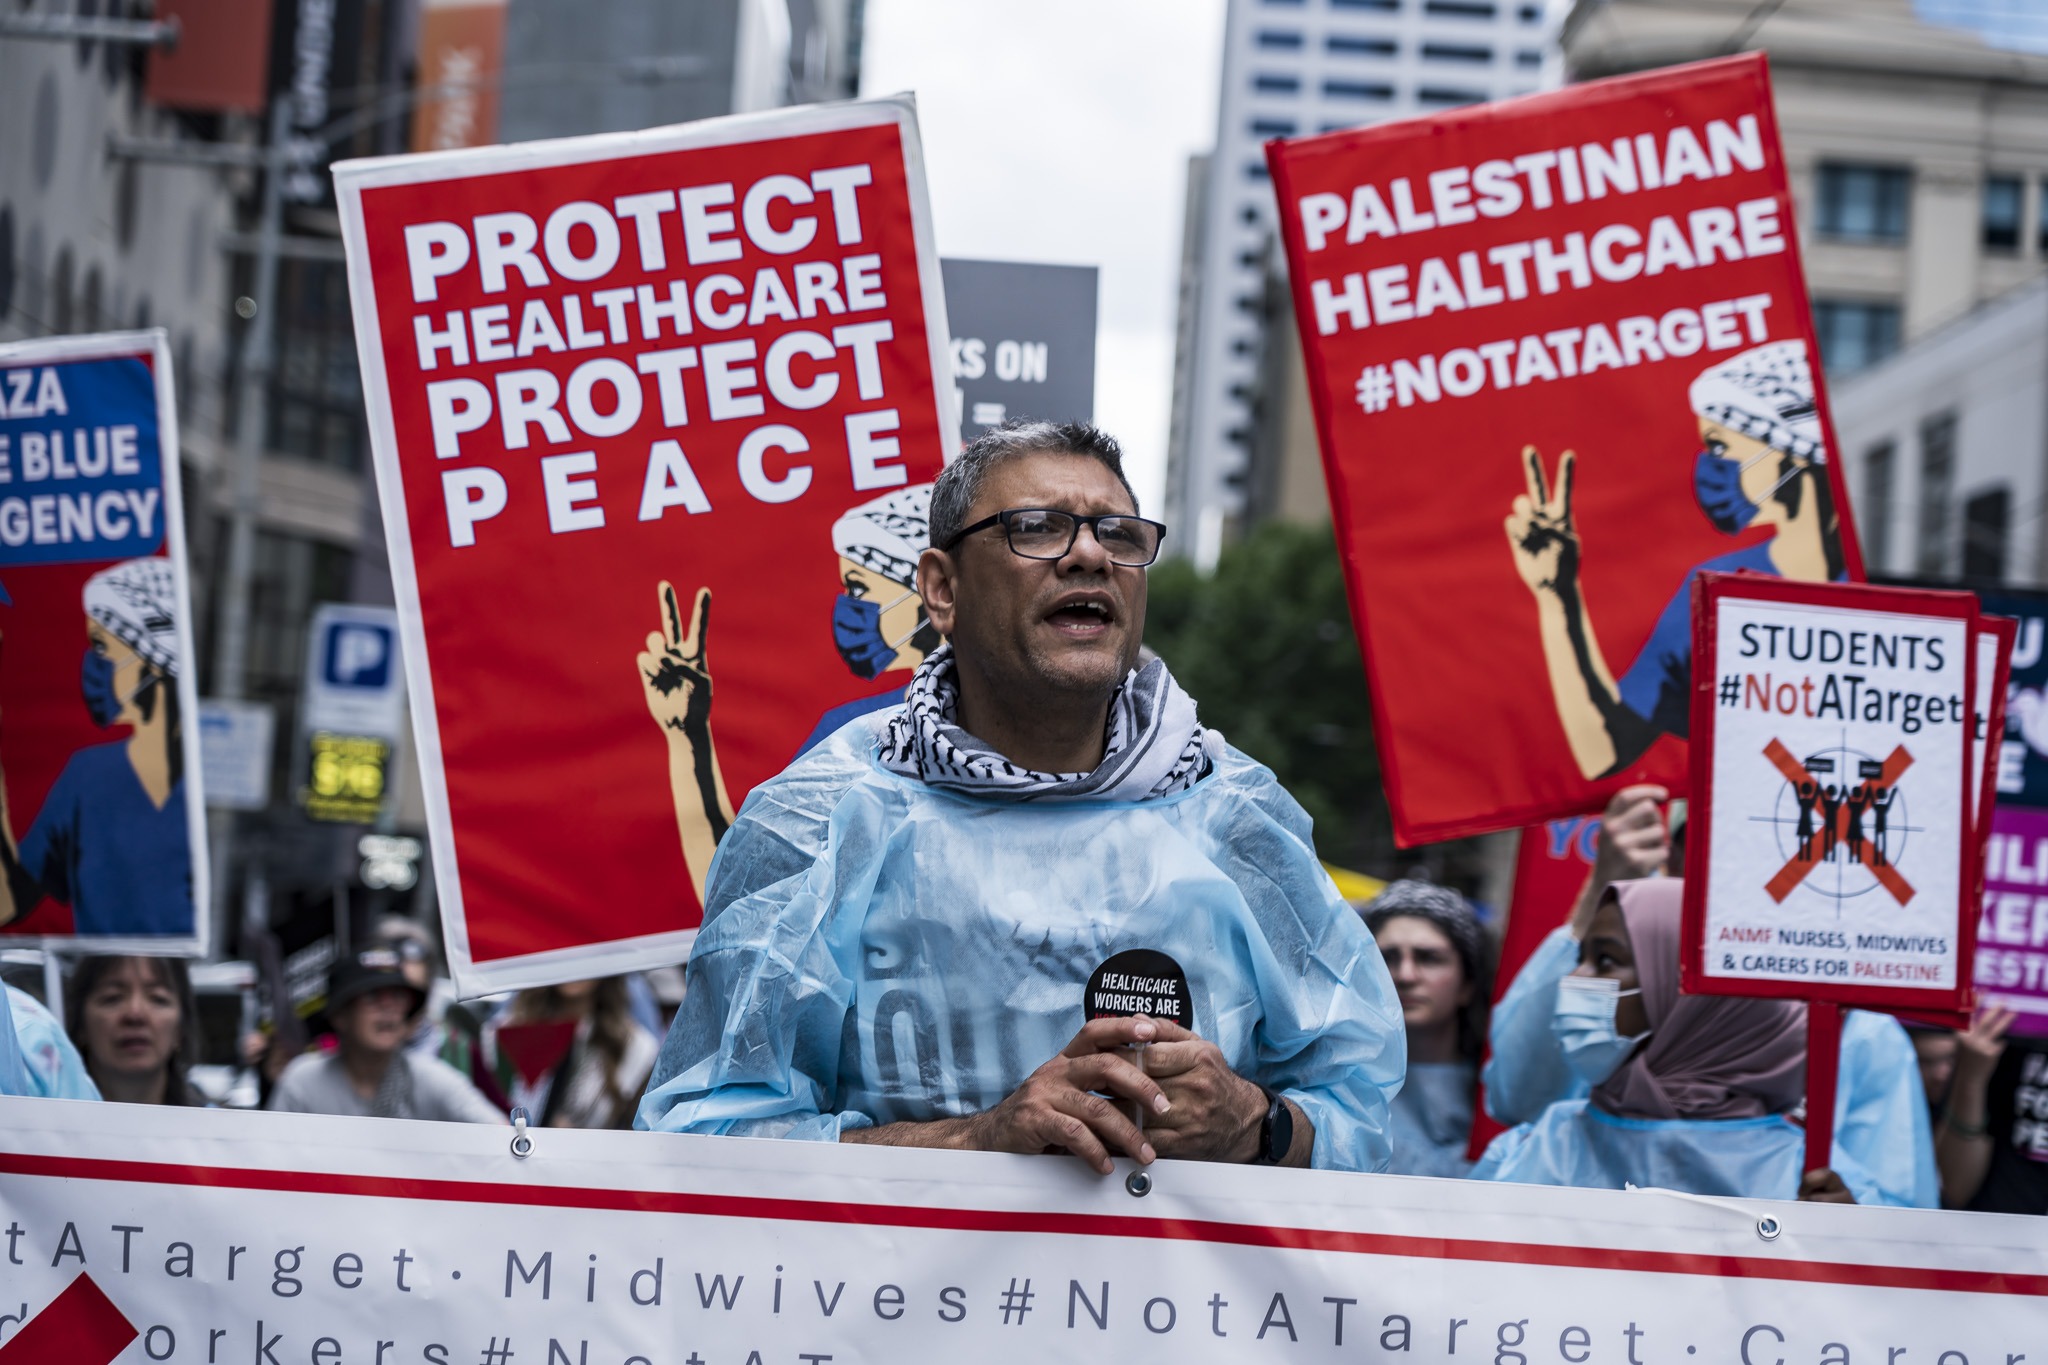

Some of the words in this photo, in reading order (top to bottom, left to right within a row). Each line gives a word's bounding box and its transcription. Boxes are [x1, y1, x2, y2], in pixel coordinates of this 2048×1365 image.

[1299, 114, 1765, 252] PALESTINIAN
[404, 164, 873, 303] PROTECT
[1311, 197, 1786, 336] HEALTHCARE
[412, 253, 887, 371] HEALTHCARE
[994, 339, 1048, 383] ON
[1355, 293, 1773, 414] #NOTATARGET
[0, 366, 68, 420] ZA
[426, 320, 895, 460] PROTECT
[21, 424, 141, 482] BLUE
[441, 408, 908, 548] PEACE
[1739, 622, 1945, 672] STUDENTS
[1719, 672, 1963, 734] #NotATarget
[1718, 926, 1774, 944] ANMF
[1778, 929, 1851, 952] NURSES,
[1856, 934, 1948, 955] MIDWIVES
[1723, 953, 1736, 971] &
[1741, 954, 1810, 974] CARERS
[1814, 958, 1849, 977] FOR
[1853, 961, 1943, 982] PALESTINE
[1094, 991, 1153, 1014] WORKERS
[1155, 997, 1181, 1016] ARE
[1101, 972, 1178, 995] HEALTHCARE
